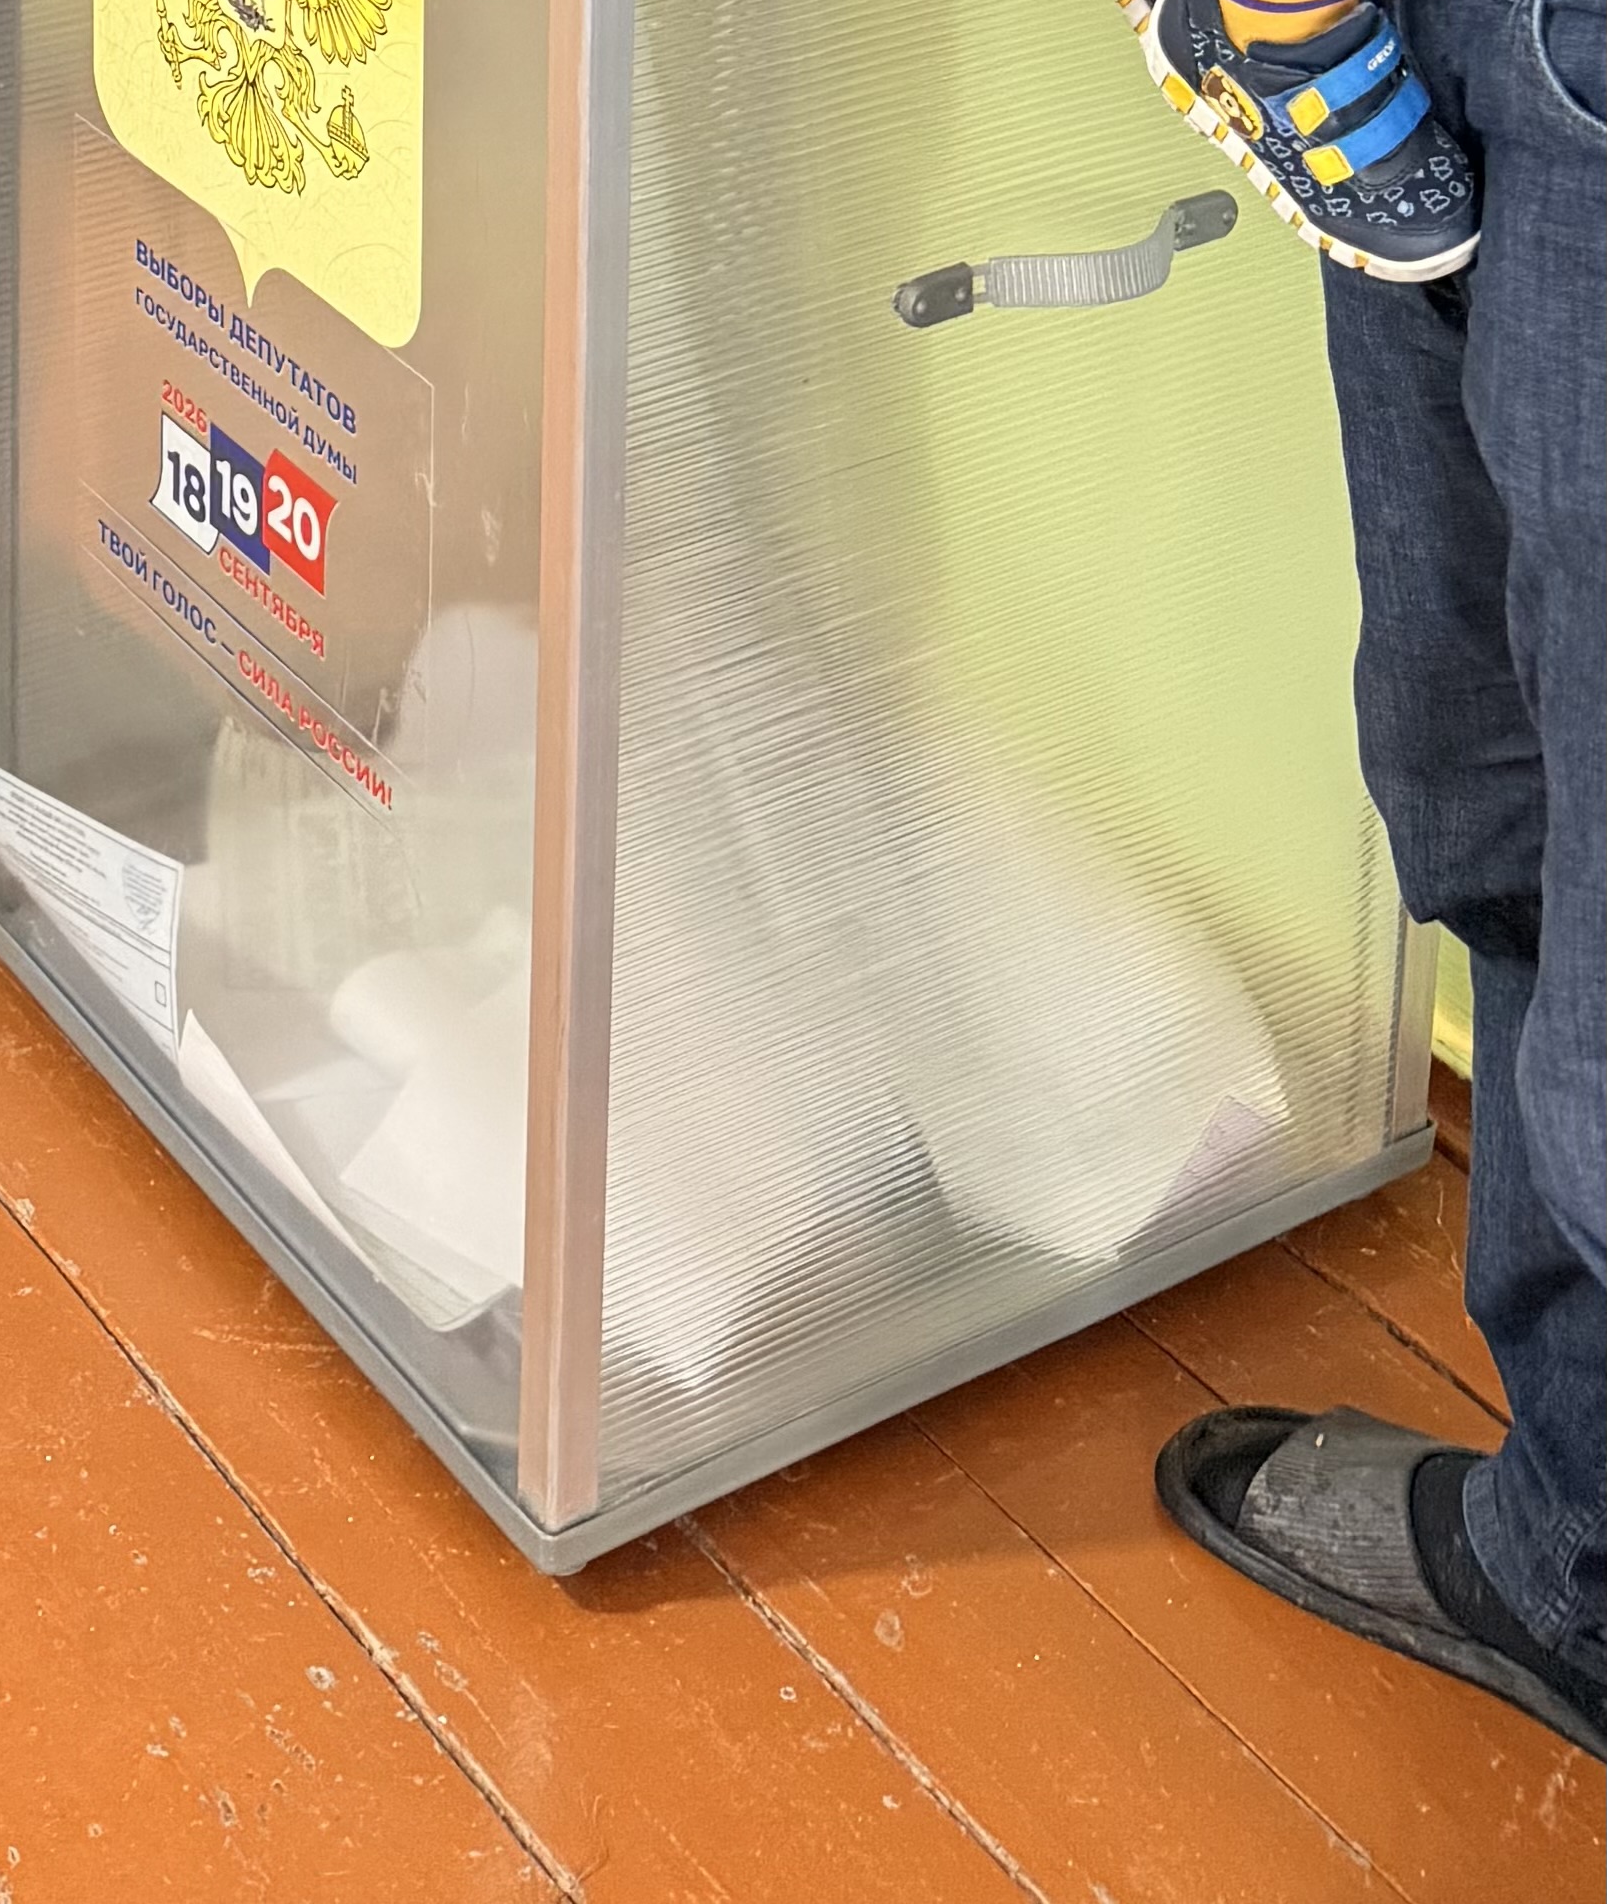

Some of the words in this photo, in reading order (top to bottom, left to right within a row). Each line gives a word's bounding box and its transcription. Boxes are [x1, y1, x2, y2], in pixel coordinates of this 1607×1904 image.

[135, 239, 225, 328] ВЫБОРЫ
[228, 311, 357, 435] ДЕПУТАТОВ
[135, 287, 301, 436] ГОСУДАРСТВЕННОЙ
[303, 428, 357, 485] ДУМЫ
[161, 379, 208, 434] 2026
[167, 450, 206, 524] 18
[216, 459, 258, 537] 19
[267, 475, 321, 561] 20
[98, 519, 148, 584] ТВОЙ
[153, 567, 217, 645] ГОЛОС
[239, 649, 293, 720] СИЛА
[298, 702, 392, 810] РОССИИ!
[219, 547, 325, 660] СЕНТЯБРЯ
